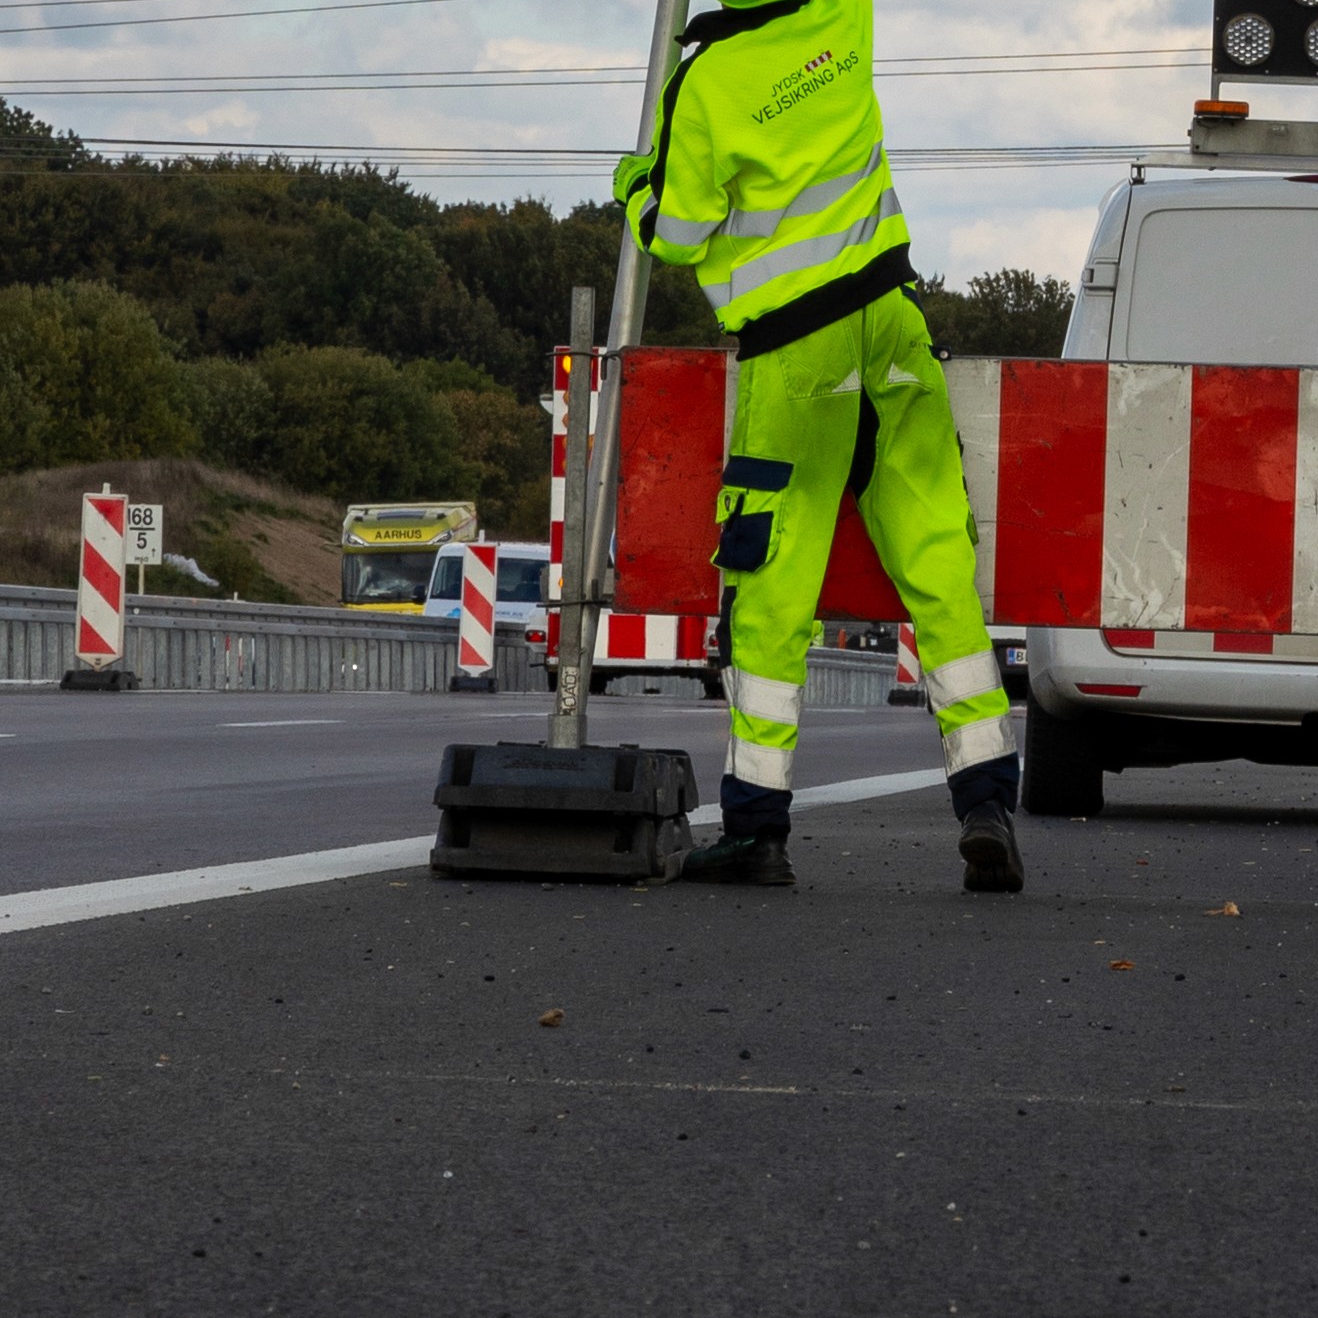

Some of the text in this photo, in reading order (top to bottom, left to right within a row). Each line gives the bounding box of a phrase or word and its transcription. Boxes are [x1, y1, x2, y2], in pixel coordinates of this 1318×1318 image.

[751, 50, 860, 125] VEJSIKRING ApS
[771, 68, 806, 98] JYDSK
[136, 531, 148, 550] 5
[374, 529, 423, 540] AARHUS
